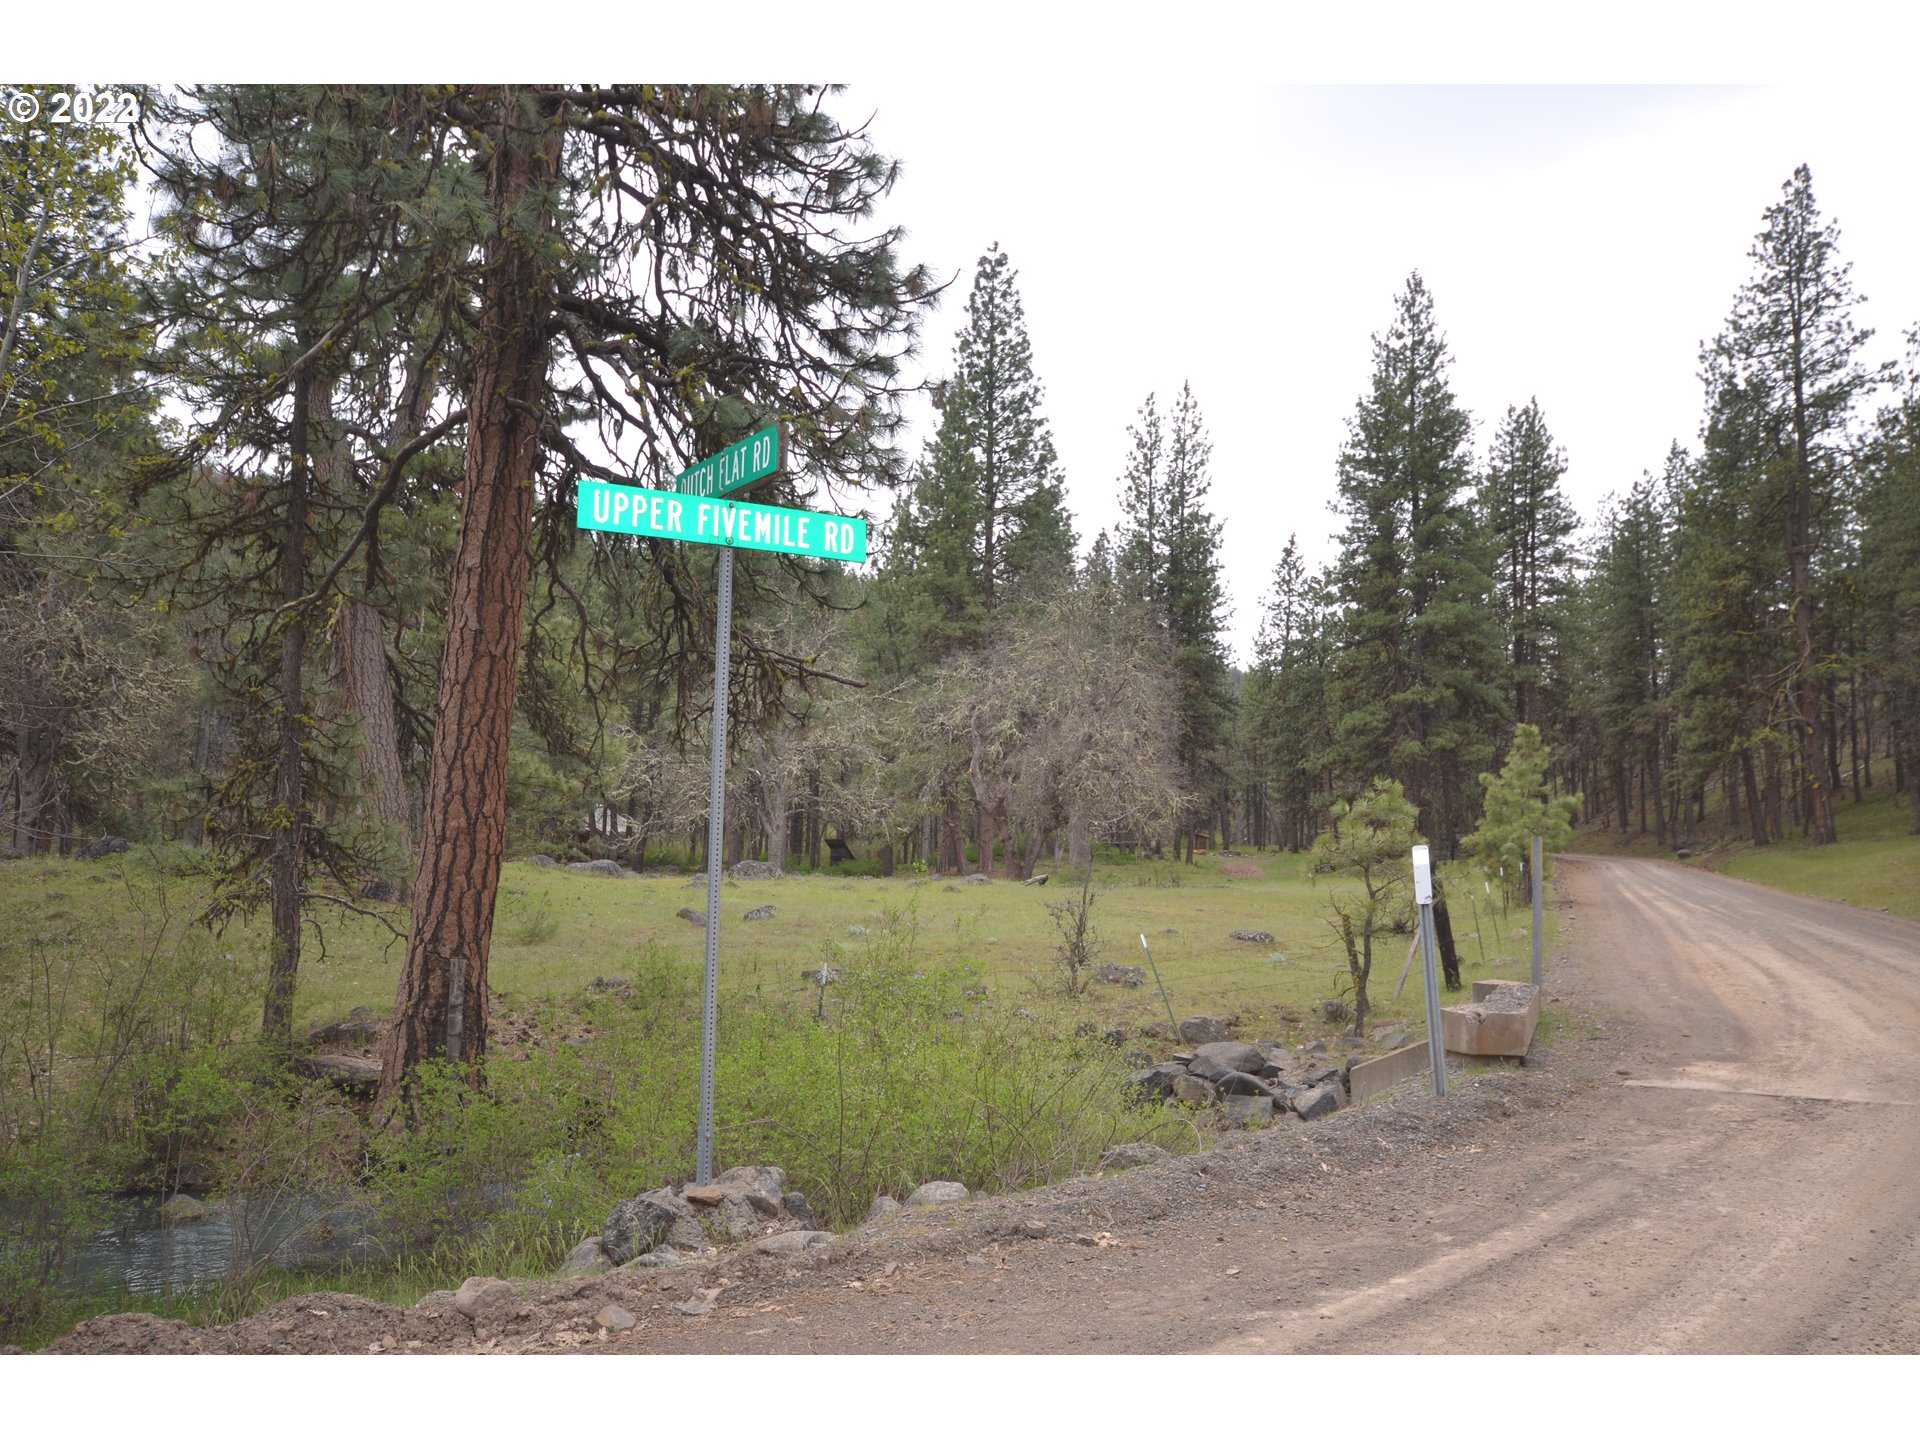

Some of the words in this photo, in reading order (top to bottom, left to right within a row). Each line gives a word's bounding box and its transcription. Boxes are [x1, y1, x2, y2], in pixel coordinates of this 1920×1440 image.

[719, 446, 747, 491] FLAT
[753, 436, 771, 473] RD
[593, 489, 683, 533] UPPER
[698, 504, 810, 549] FIVEMILE
[825, 521, 854, 555] RD
